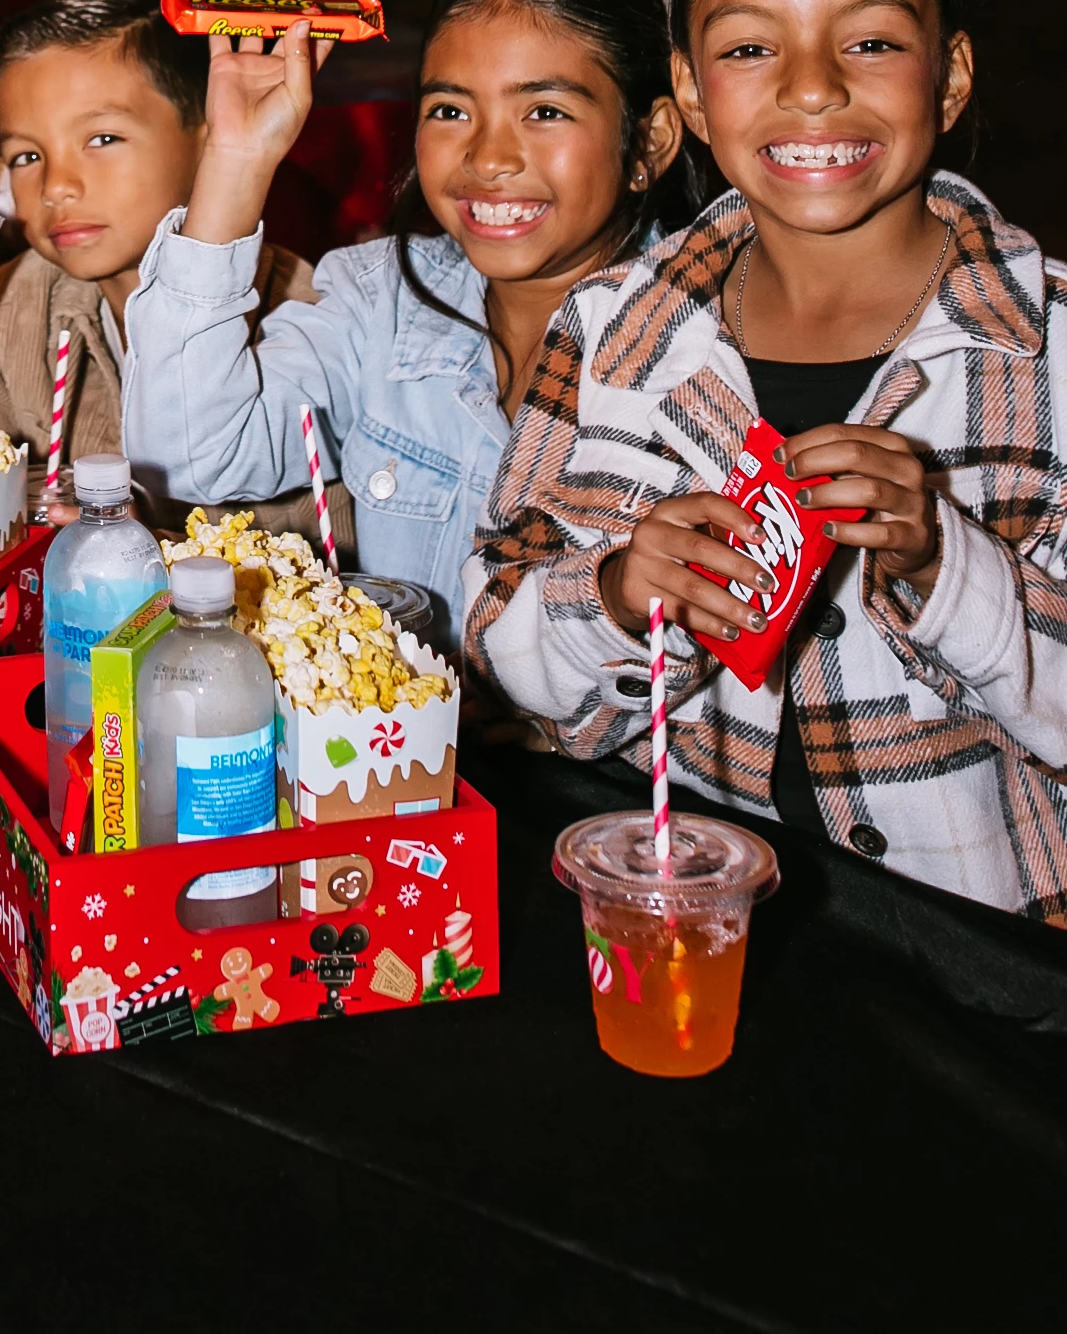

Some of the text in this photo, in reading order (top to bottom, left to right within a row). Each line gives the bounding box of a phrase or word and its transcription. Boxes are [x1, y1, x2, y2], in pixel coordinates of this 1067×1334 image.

[63, 641, 92, 663] PAR
[100, 711, 124, 759] Kids
[103, 759, 126, 836] PATCH
[85, 1025, 106, 1038] CORN
[87, 1017, 103, 1028] POP
